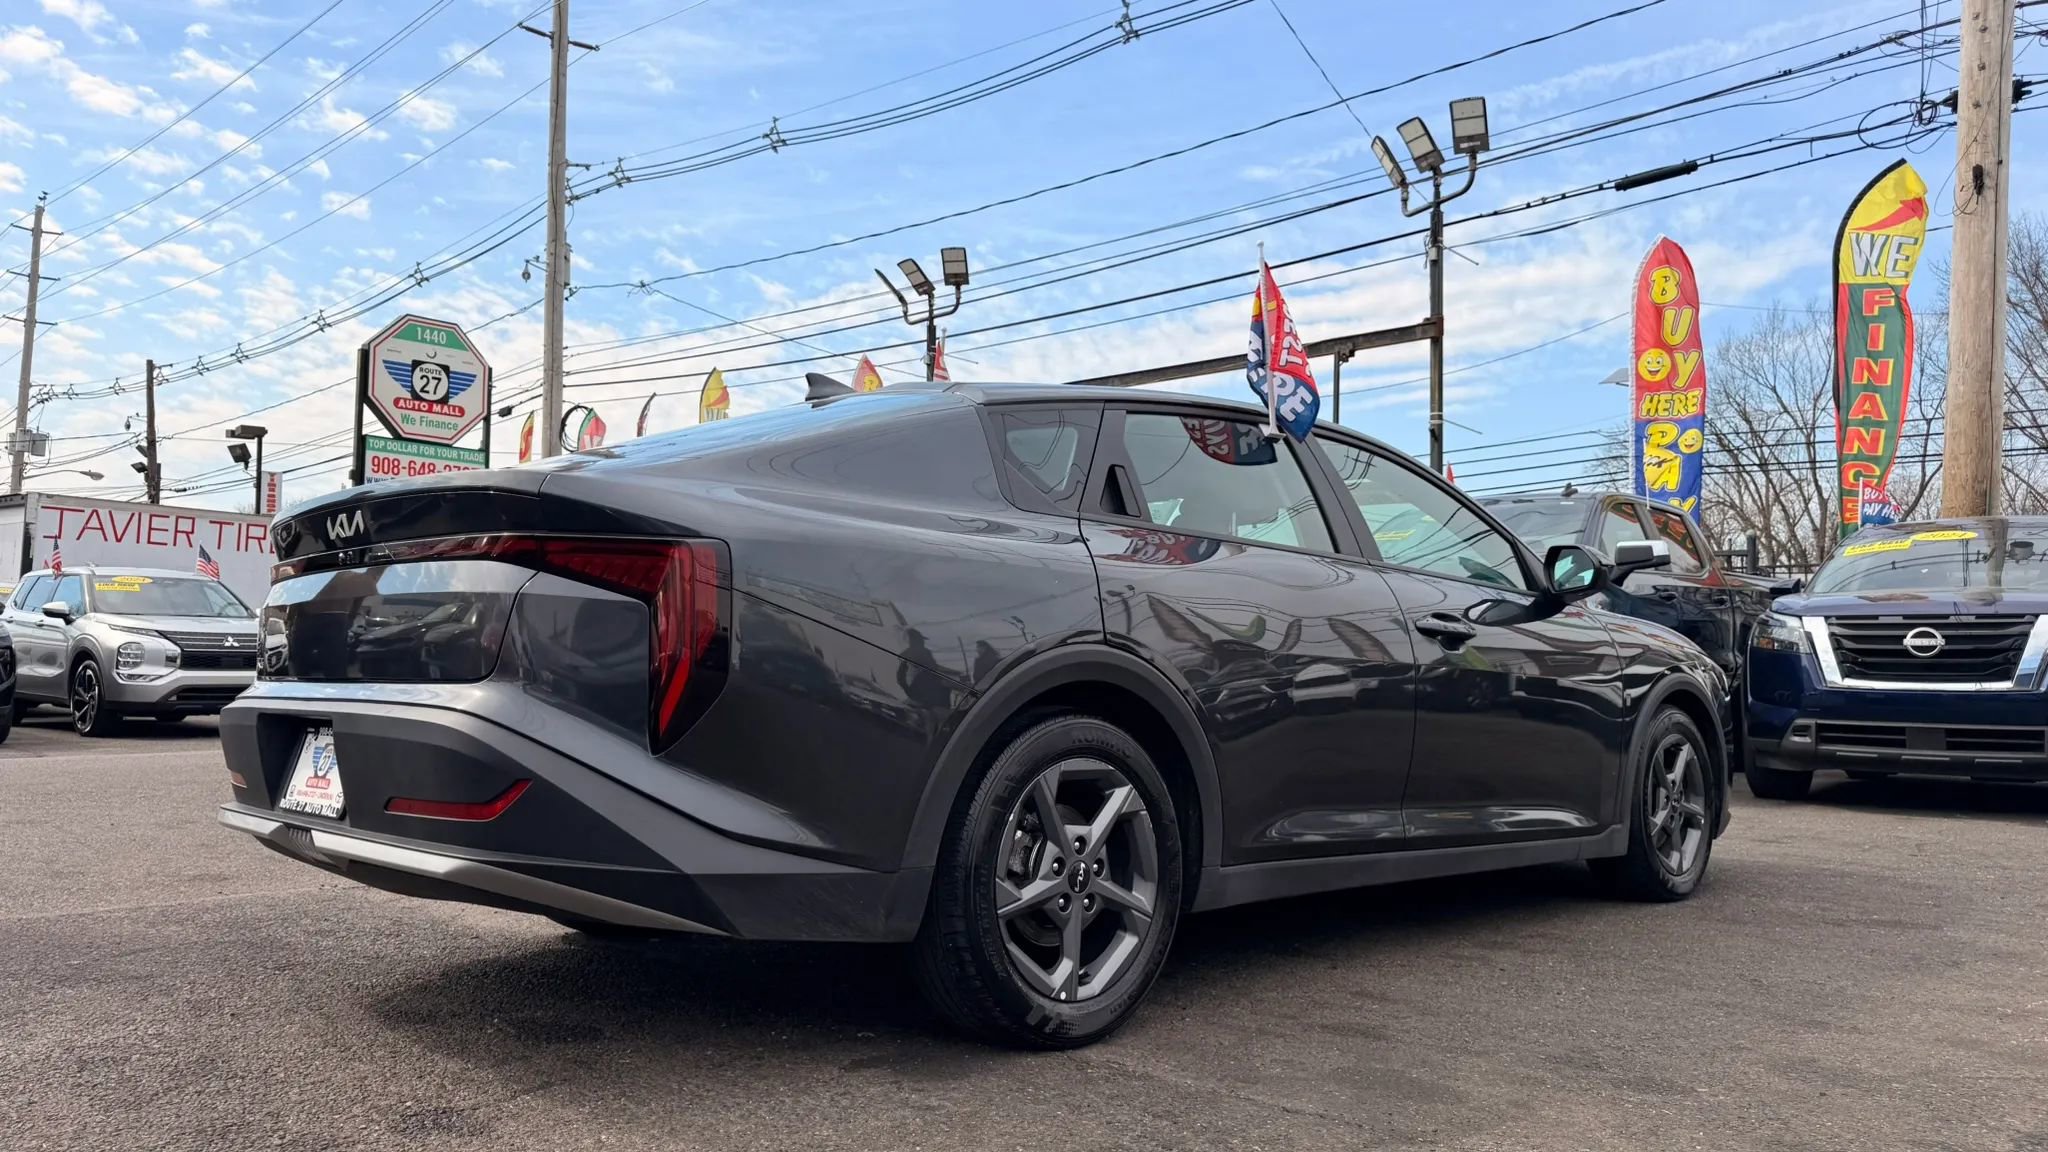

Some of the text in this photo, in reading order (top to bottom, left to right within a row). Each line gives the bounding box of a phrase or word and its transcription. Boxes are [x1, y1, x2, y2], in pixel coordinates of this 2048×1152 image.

[1849, 231, 1919, 278] WE
[416, 327, 447, 345] 1440
[1649, 266, 1701, 389] BUY
[419, 366, 442, 376] ROUTE
[419, 374, 442, 395] 27
[397, 399, 462, 416] AUTO MALL
[1640, 388, 1701, 418] HERE
[1841, 288, 1896, 524] FINANCE
[400, 413, 459, 431] We Finance
[368, 438, 485, 463] TOP DOLLAR FOR YOUR TRADE
[1863, 503, 1882, 516] PAY
[41, 505, 275, 554] JAVIER TIR
[326, 510, 365, 540] KIA
[304, 802, 322, 815] AUTO
[321, 804, 337, 818] MALL
